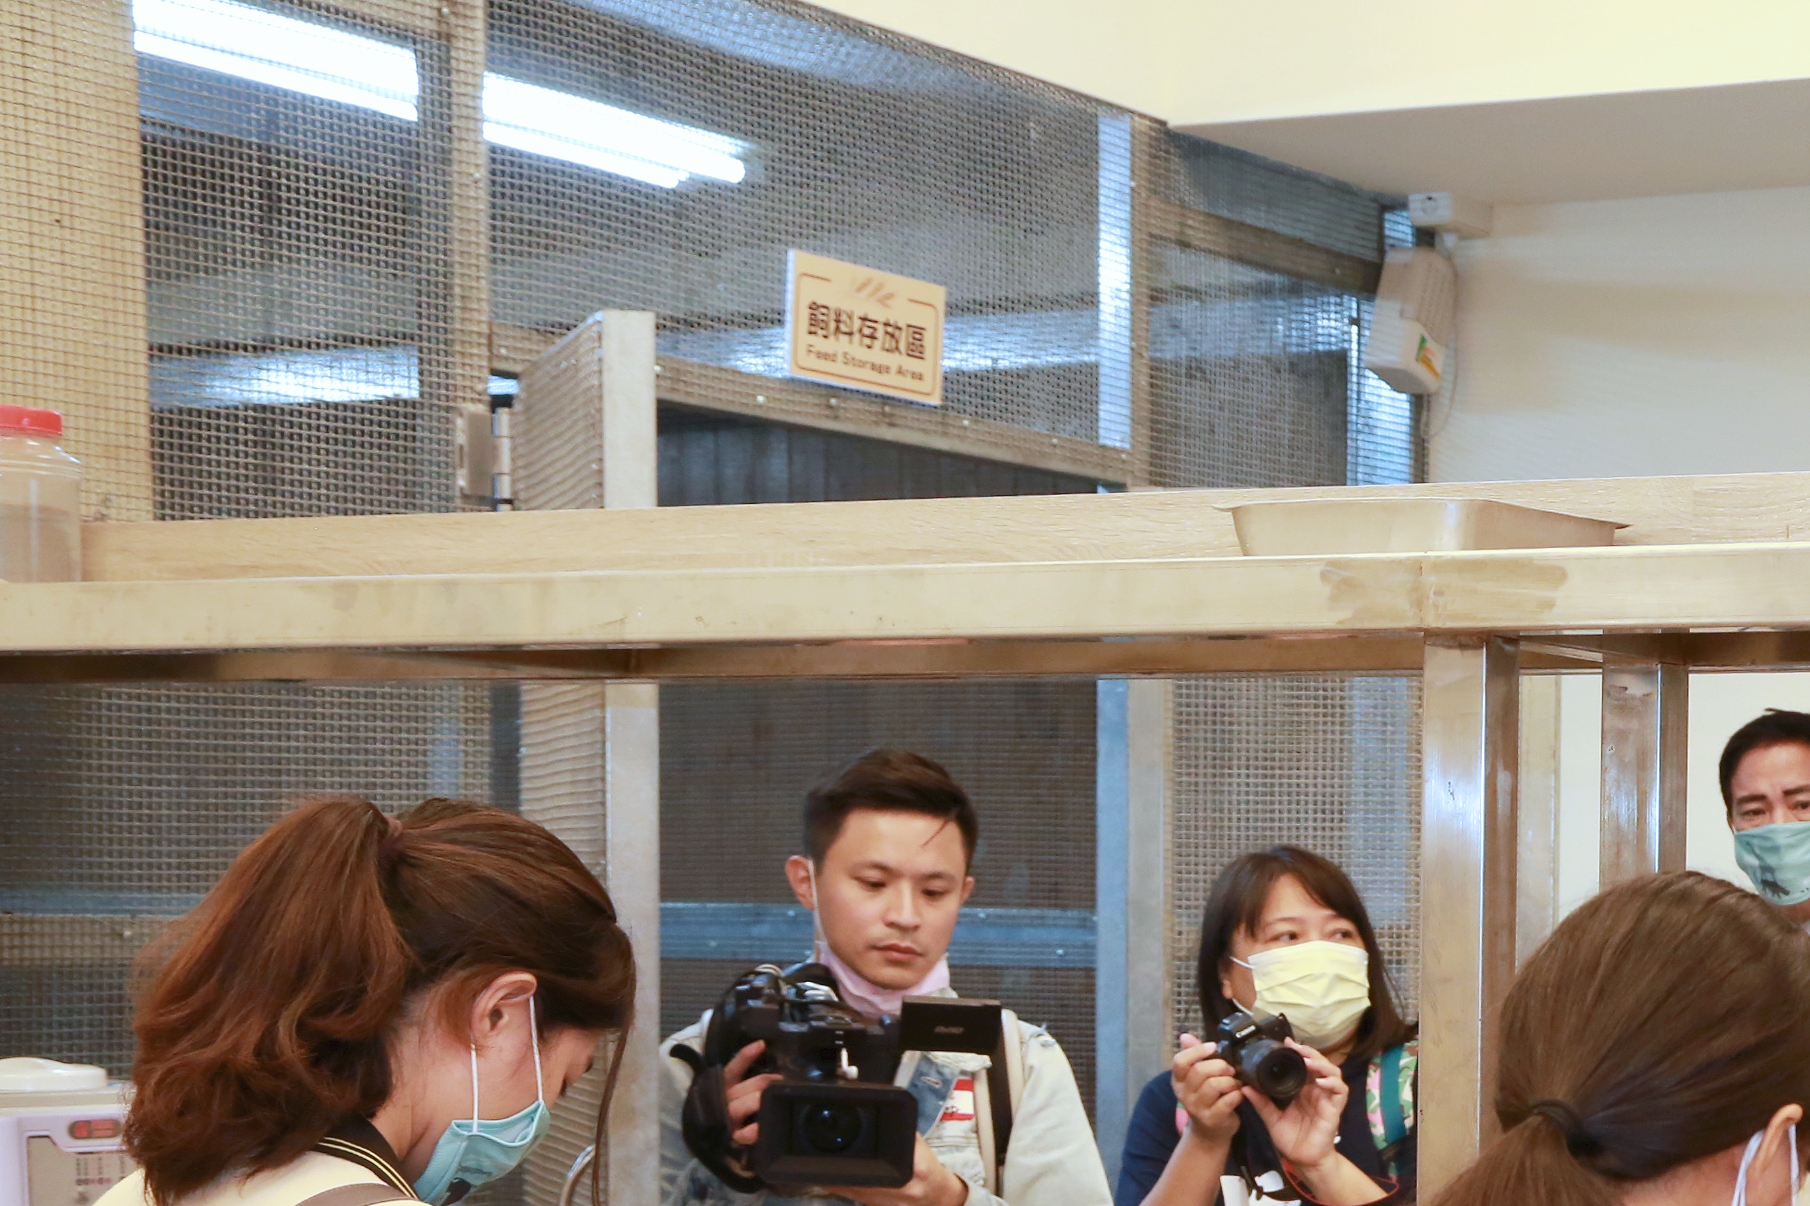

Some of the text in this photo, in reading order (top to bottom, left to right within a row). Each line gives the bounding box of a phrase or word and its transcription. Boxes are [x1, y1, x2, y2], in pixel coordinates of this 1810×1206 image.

[807, 301, 926, 360] 飼料存放區
[806, 344, 924, 382] Feed Storage Area
